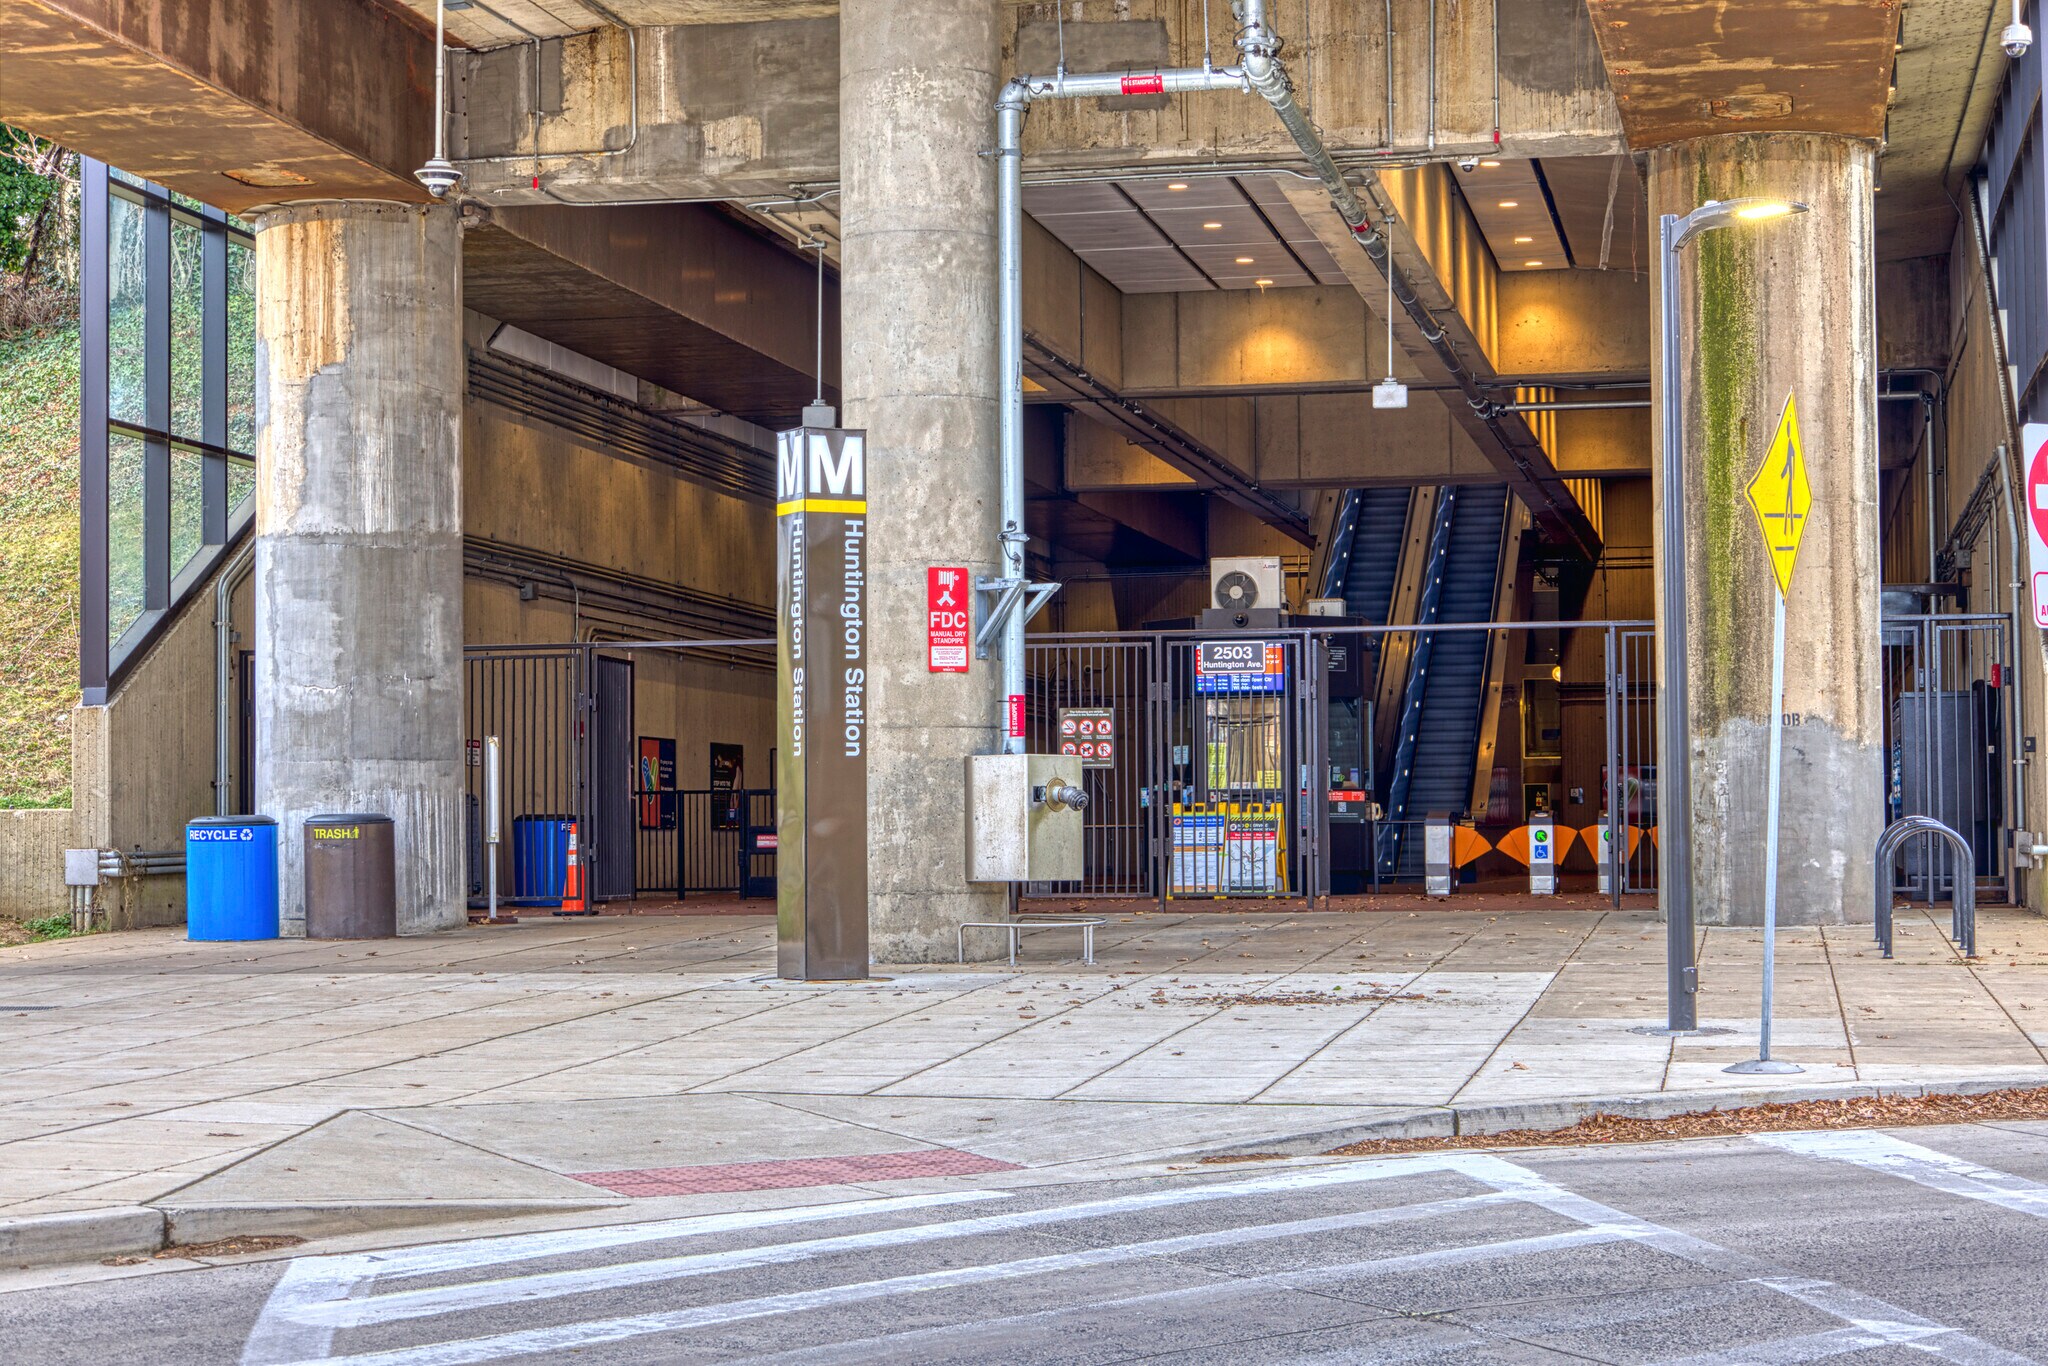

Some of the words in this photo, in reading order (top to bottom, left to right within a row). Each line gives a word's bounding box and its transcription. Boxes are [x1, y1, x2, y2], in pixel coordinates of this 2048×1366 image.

[778, 435, 803, 498] M
[809, 434, 863, 495] M
[791, 519, 803, 659] Huntington
[840, 520, 864, 659] Huntington
[930, 611, 966, 628] FDC
[1203, 661, 1245, 670] Huntington
[1213, 646, 1253, 659] 2503
[793, 667, 804, 757] Station
[845, 667, 865, 757] Station
[189, 829, 237, 840] RECYCLE
[313, 828, 350, 839] TRASH
